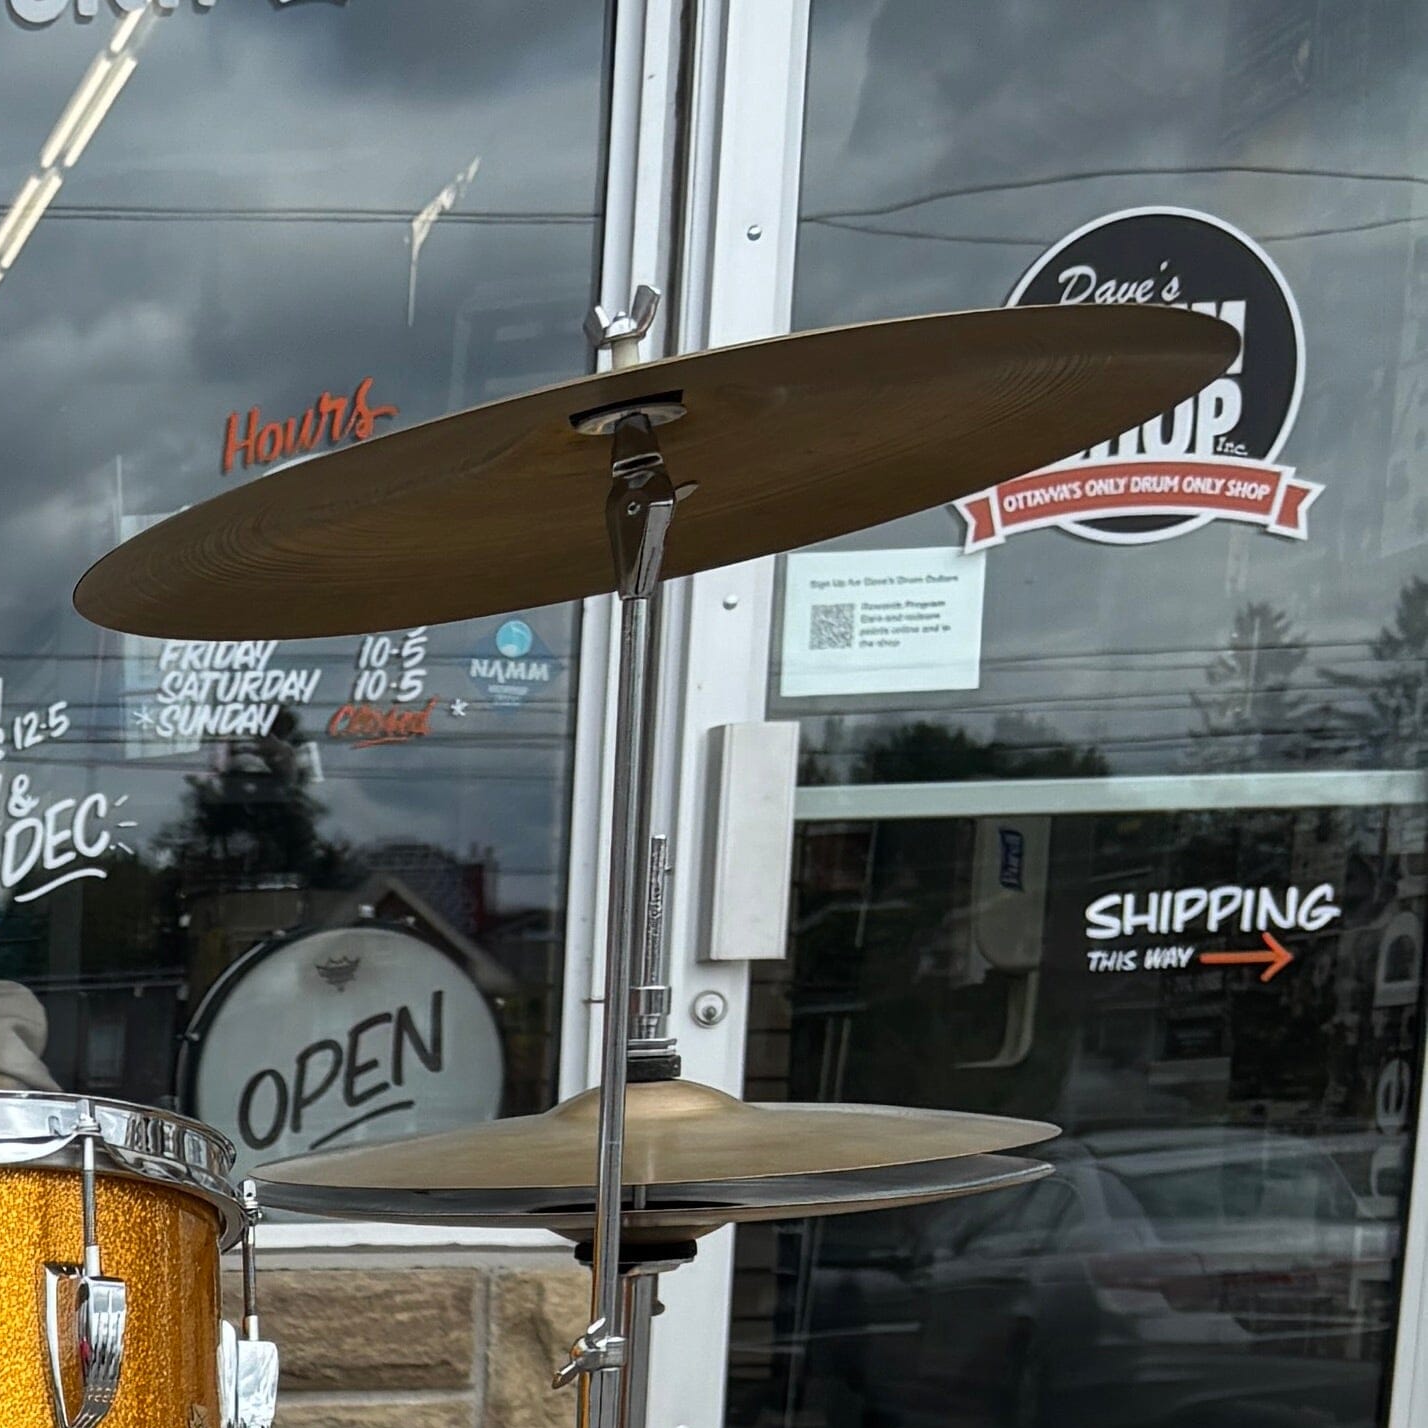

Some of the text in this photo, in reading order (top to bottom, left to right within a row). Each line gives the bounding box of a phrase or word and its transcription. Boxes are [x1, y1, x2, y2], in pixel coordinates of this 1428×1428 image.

[1058, 260, 1182, 306] Dave's
[225, 376, 399, 472] Hours
[1082, 378, 1243, 459] OP
[1003, 476, 1271, 513] OTTAWA'S ONLY DRUM ONLY SHOP
[160, 640, 278, 670] FRIDAY
[470, 658, 549, 684] NAMM
[157, 669, 322, 703] SATURDAY
[156, 703, 279, 737] SUNDAY
[8, 774, 39, 817] &
[1085, 883, 1342, 940] SHIPPING
[1087, 946, 1196, 972] THIS WAY
[239, 990, 444, 1150] OPEN
